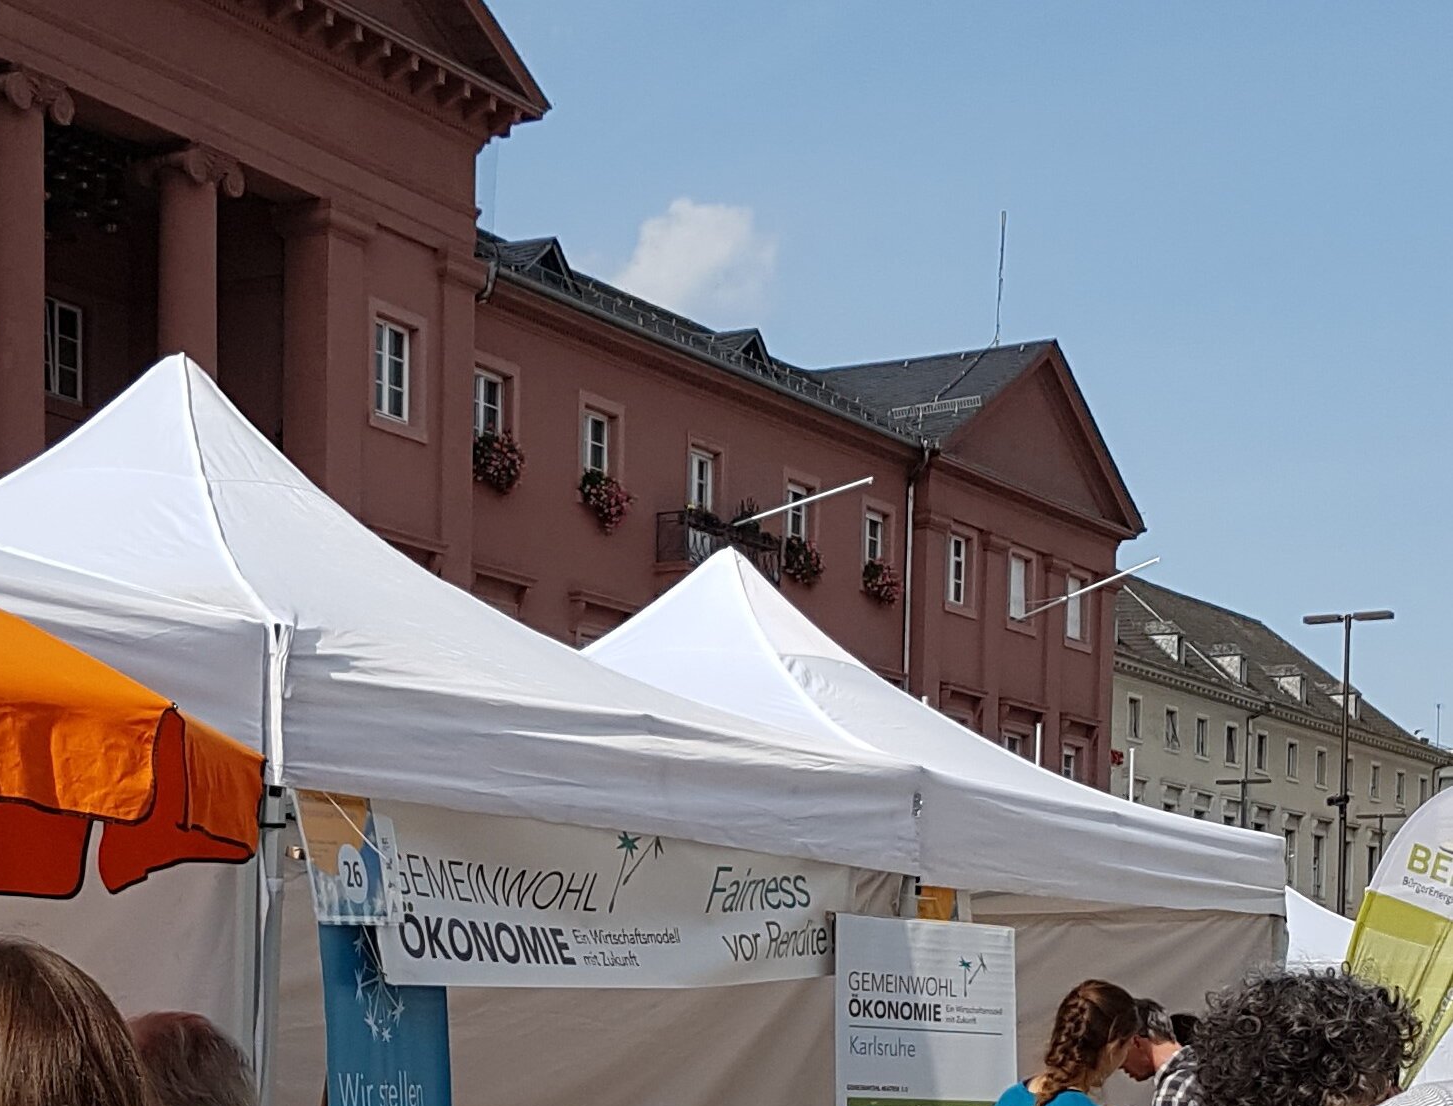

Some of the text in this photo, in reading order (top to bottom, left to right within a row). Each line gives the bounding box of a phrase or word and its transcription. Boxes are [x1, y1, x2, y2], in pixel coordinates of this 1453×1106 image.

[342, 860, 364, 889] 26
[1407, 843, 1453, 887] BE
[705, 866, 811, 914] Fairness
[399, 901, 682, 966] ÖKONOMIE Ein Wirtschaftsmodell
[721, 932, 761, 962] vor
[583, 949, 641, 967] mit Zukunft
[848, 971, 958, 998] GEMEINWOHL
[848, 993, 943, 1023] ÖKONOMIE
[849, 1035, 917, 1059] Karlsruhe
